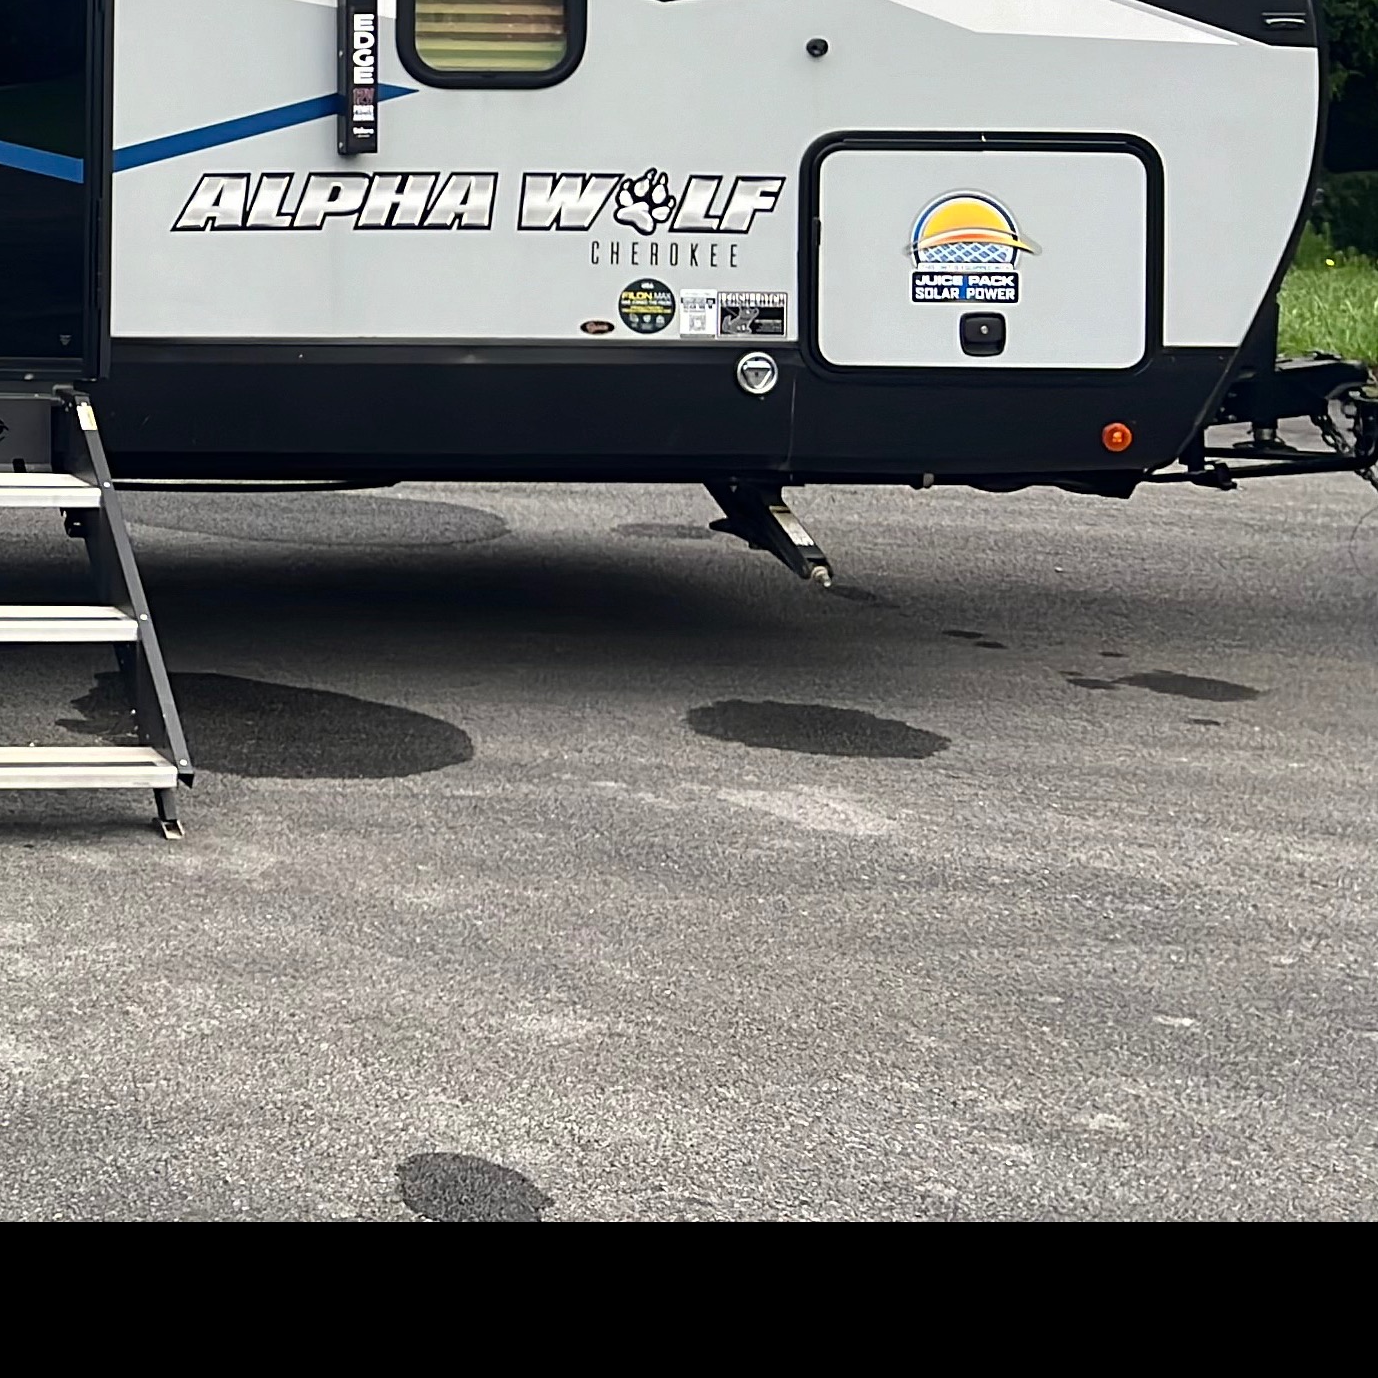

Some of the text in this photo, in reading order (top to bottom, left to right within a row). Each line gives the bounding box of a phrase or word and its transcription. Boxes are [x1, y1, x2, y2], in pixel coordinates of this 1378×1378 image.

[352, 13, 375, 85] EDGE
[171, 172, 498, 232] ALPHA
[590, 240, 739, 268] CHEROKEE
[915, 274, 1015, 287] JUICE PACK
[915, 287, 1015, 300] SOLAR POWER
